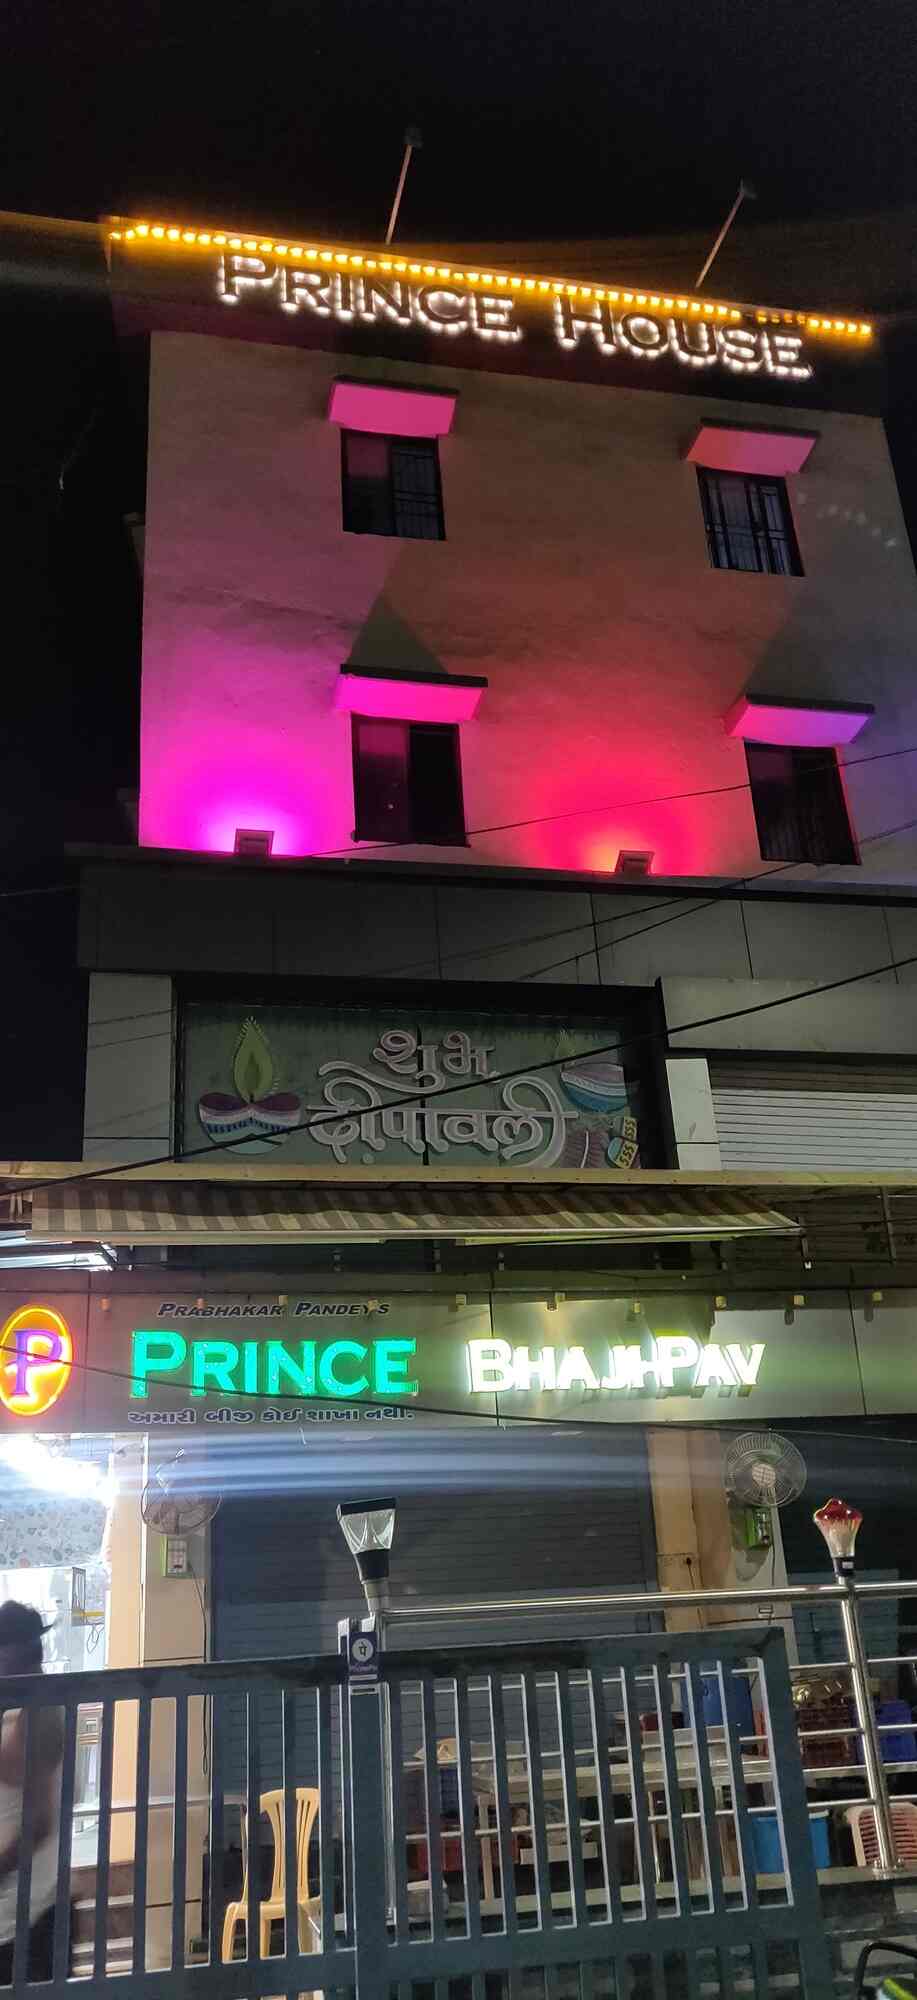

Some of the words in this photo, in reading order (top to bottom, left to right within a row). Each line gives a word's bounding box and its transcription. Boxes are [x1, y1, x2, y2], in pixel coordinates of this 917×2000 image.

[216, 252, 522, 341] PRINCE
[554, 293, 812, 378] HOUSE
[306, 1076, 579, 1168] दीपावली
[157, 1303, 282, 1317] PRABHAKAR
[295, 1302, 390, 1316] PANDEYS
[10, 1329, 64, 1397] P
[131, 1330, 419, 1398] PRINCE
[127, 1407, 197, 1424] અમારી
